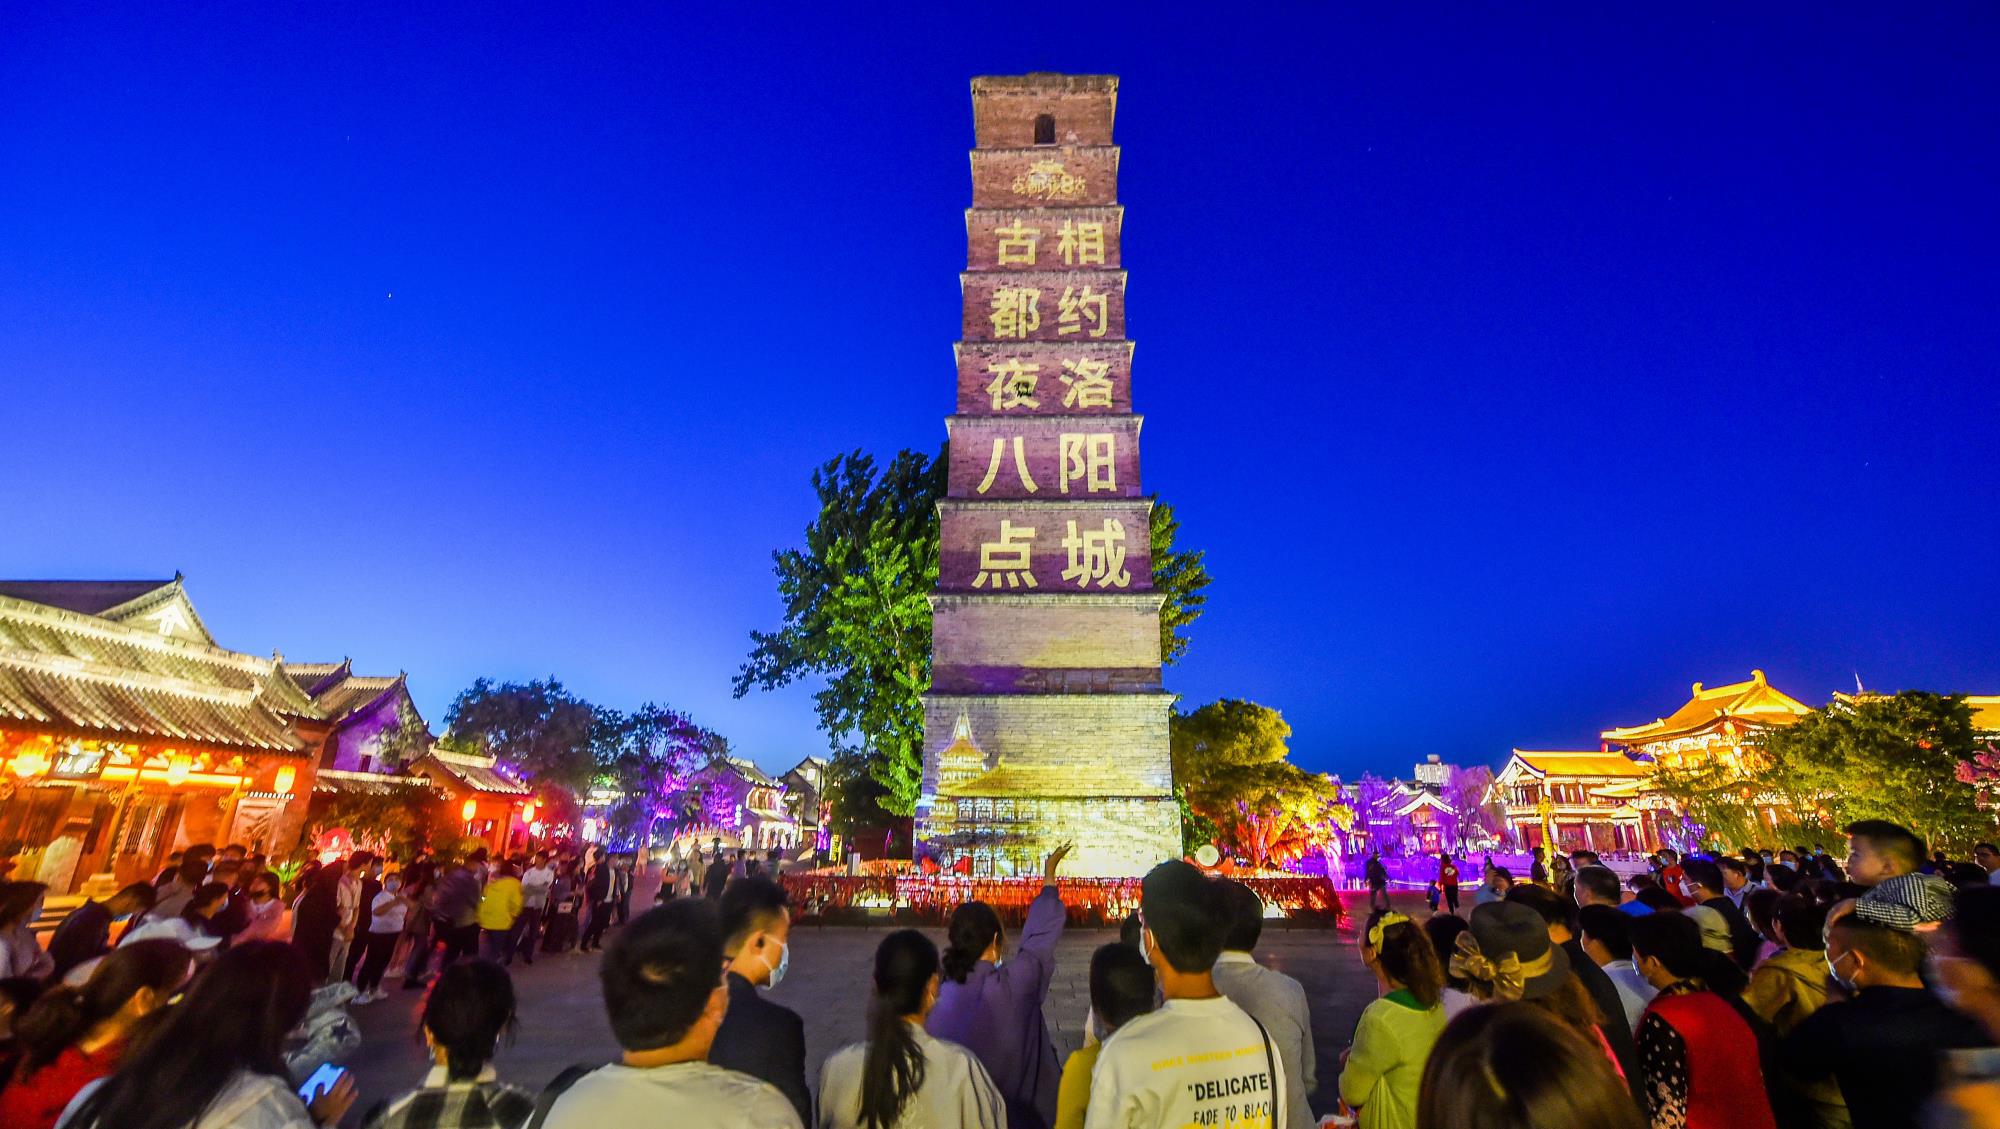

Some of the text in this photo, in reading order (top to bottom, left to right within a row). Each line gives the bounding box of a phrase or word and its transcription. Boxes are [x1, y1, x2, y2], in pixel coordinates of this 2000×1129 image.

[971, 219, 1040, 589] 古都夜八点
[1056, 219, 1131, 589] 相约洛阳城
[1193, 1108, 1218, 1126] FADE
[1225, 1104, 1237, 1122] TO
